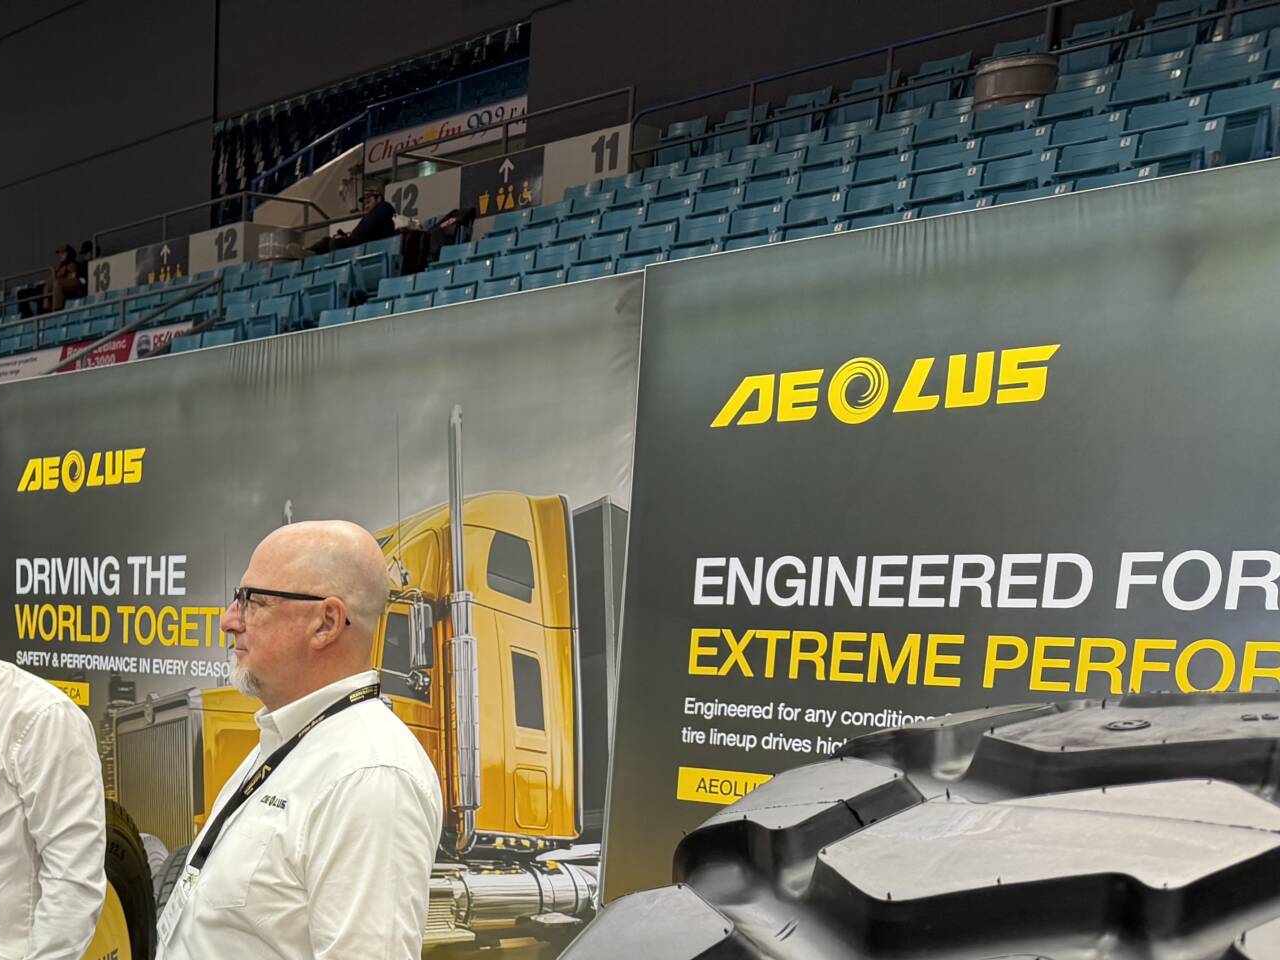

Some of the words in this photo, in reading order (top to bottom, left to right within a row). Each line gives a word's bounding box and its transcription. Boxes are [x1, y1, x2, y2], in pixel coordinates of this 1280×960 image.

[591, 131, 620, 174] 11
[391, 183, 418, 217] 12
[214, 228, 237, 262] 12
[93, 261, 111, 293] 13
[710, 343, 1062, 427] AEOLUS
[17, 447, 146, 493] AEOLUS
[15, 555, 120, 596] DRIVING
[127, 554, 187, 596] THE
[693, 551, 1093, 608] ENGINEERED
[1115, 550, 1280, 610] FOR
[14, 603, 110, 643] WORLD
[16, 650, 51, 667] SAFETY
[52, 653, 59, 668] &
[60, 654, 137, 674] PERFORMANCE
[139, 658, 151, 674] IN
[152, 659, 188, 677] EVERY
[190, 661, 231, 679] SEASO
[688, 628, 966, 687] EXTREME
[684, 697, 773, 720] Engineered
[777, 702, 801, 721] for
[804, 708, 837, 728] any
[681, 726, 706, 744] tire
[709, 728, 757, 752] lineup
[761, 732, 812, 754] drives
[816, 736, 848, 756] hig
[259, 794, 288, 810] AEOLUS
